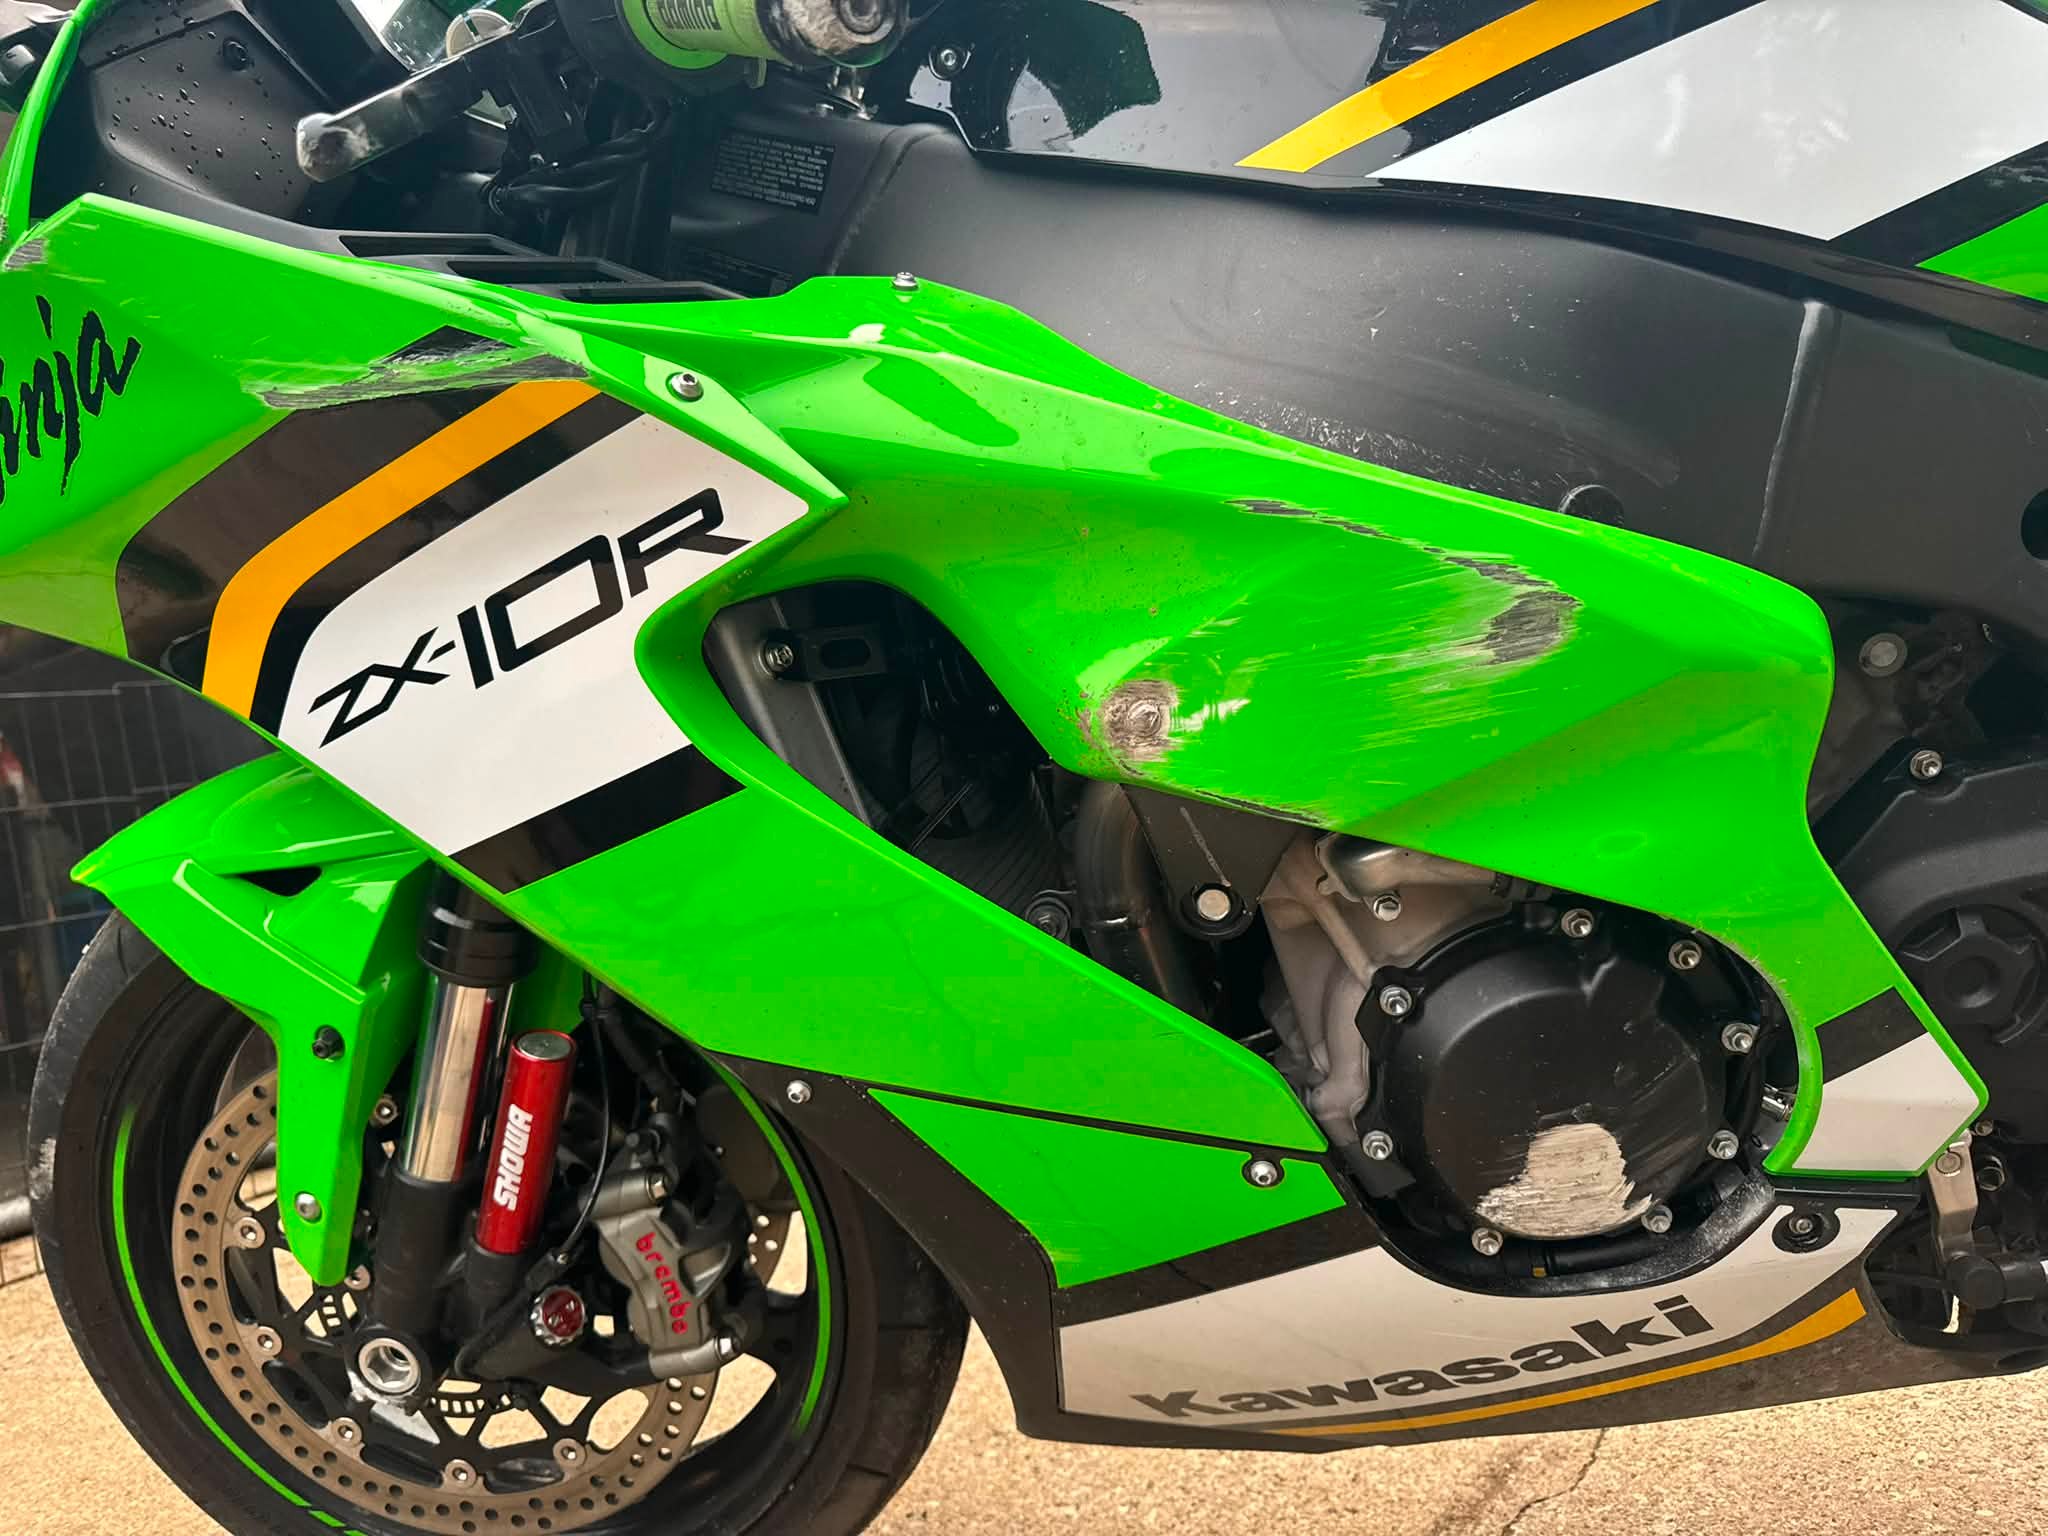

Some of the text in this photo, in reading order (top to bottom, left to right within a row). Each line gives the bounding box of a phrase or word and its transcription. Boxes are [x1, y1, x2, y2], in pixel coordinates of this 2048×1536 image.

[308, 488, 752, 749] ZX-10R
[493, 1103, 533, 1212] SHOWA
[636, 1231, 692, 1335] brembo
[1130, 1294, 1715, 1419] Kawasaki
